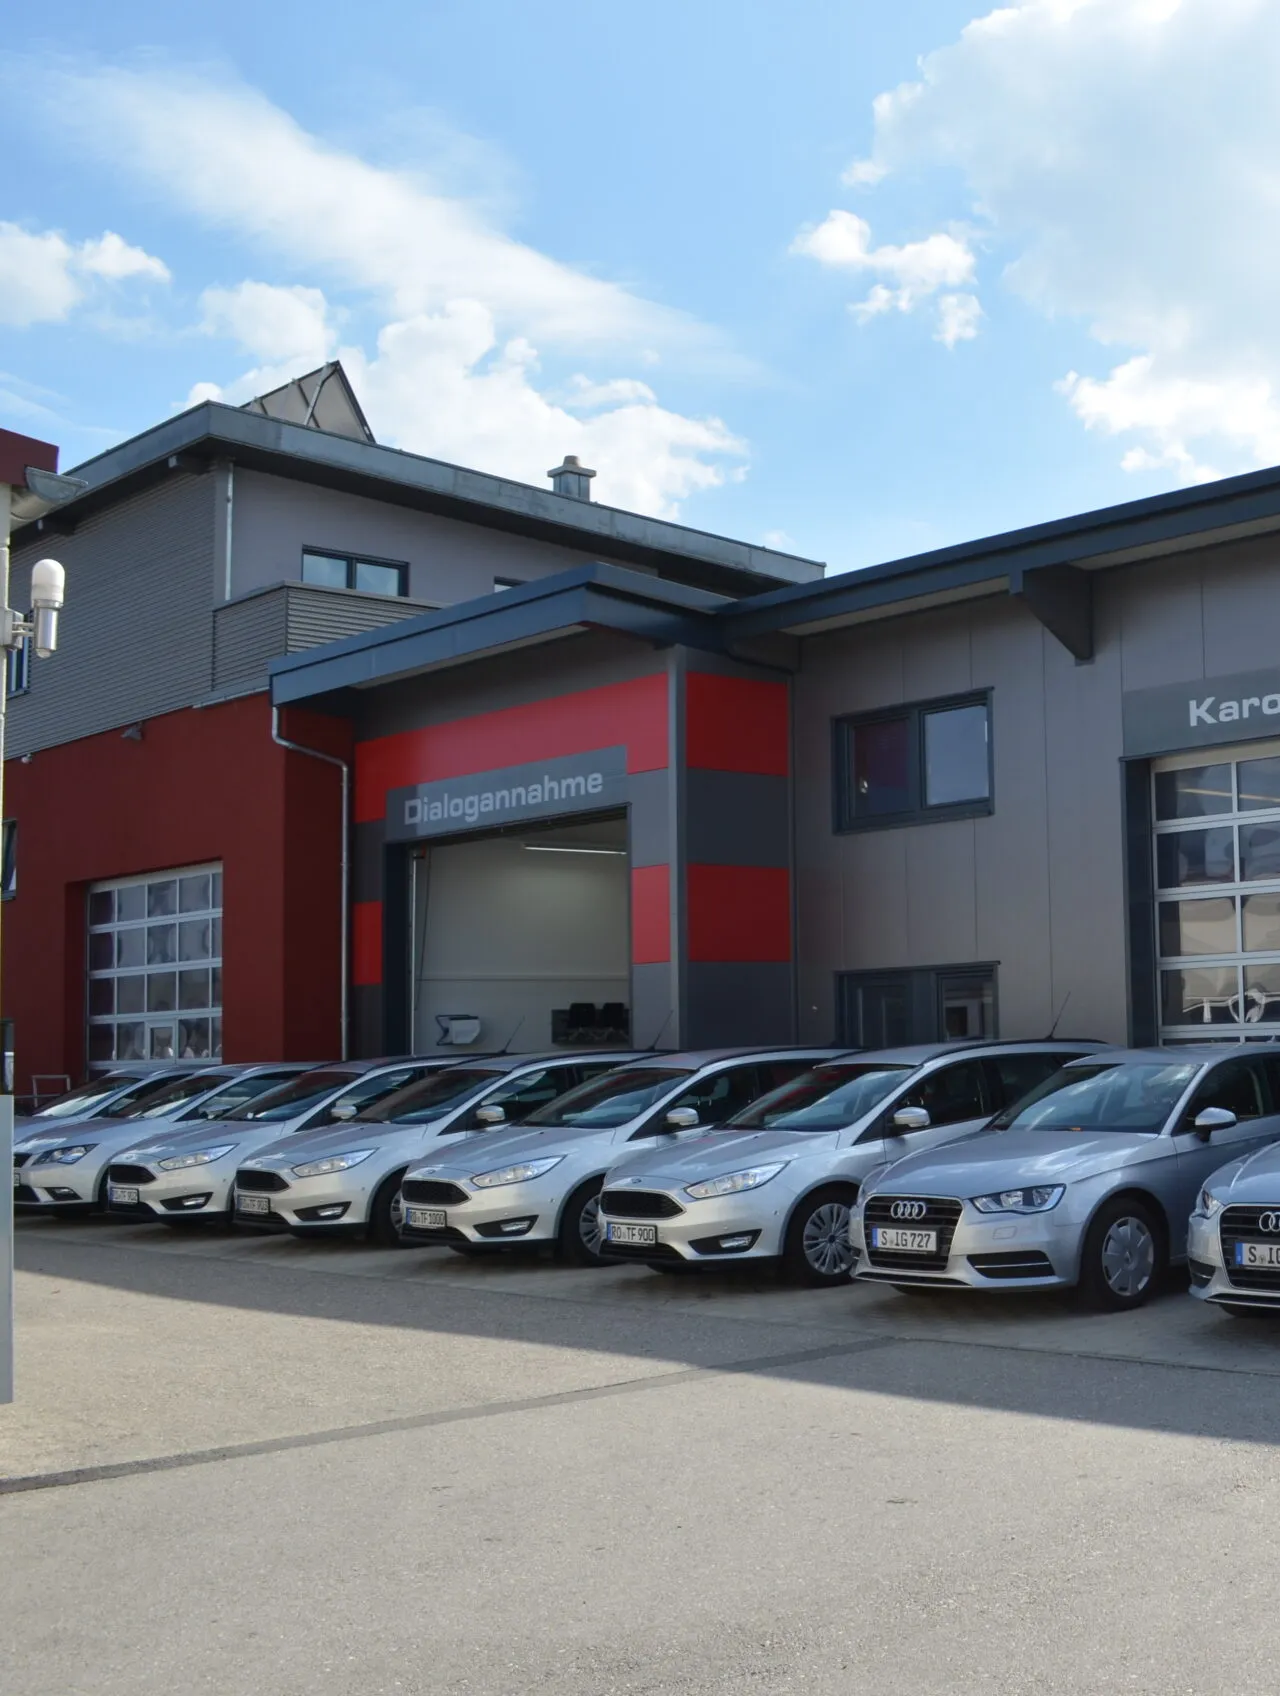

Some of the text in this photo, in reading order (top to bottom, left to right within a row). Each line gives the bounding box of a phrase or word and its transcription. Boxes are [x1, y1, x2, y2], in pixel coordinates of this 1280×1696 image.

[404, 771, 604, 825] Dialogannahme
[611, 1225, 654, 1241] RO TF 900
[881, 1230, 931, 1249] S IG 727
[1248, 1245, 1257, 1263] S
